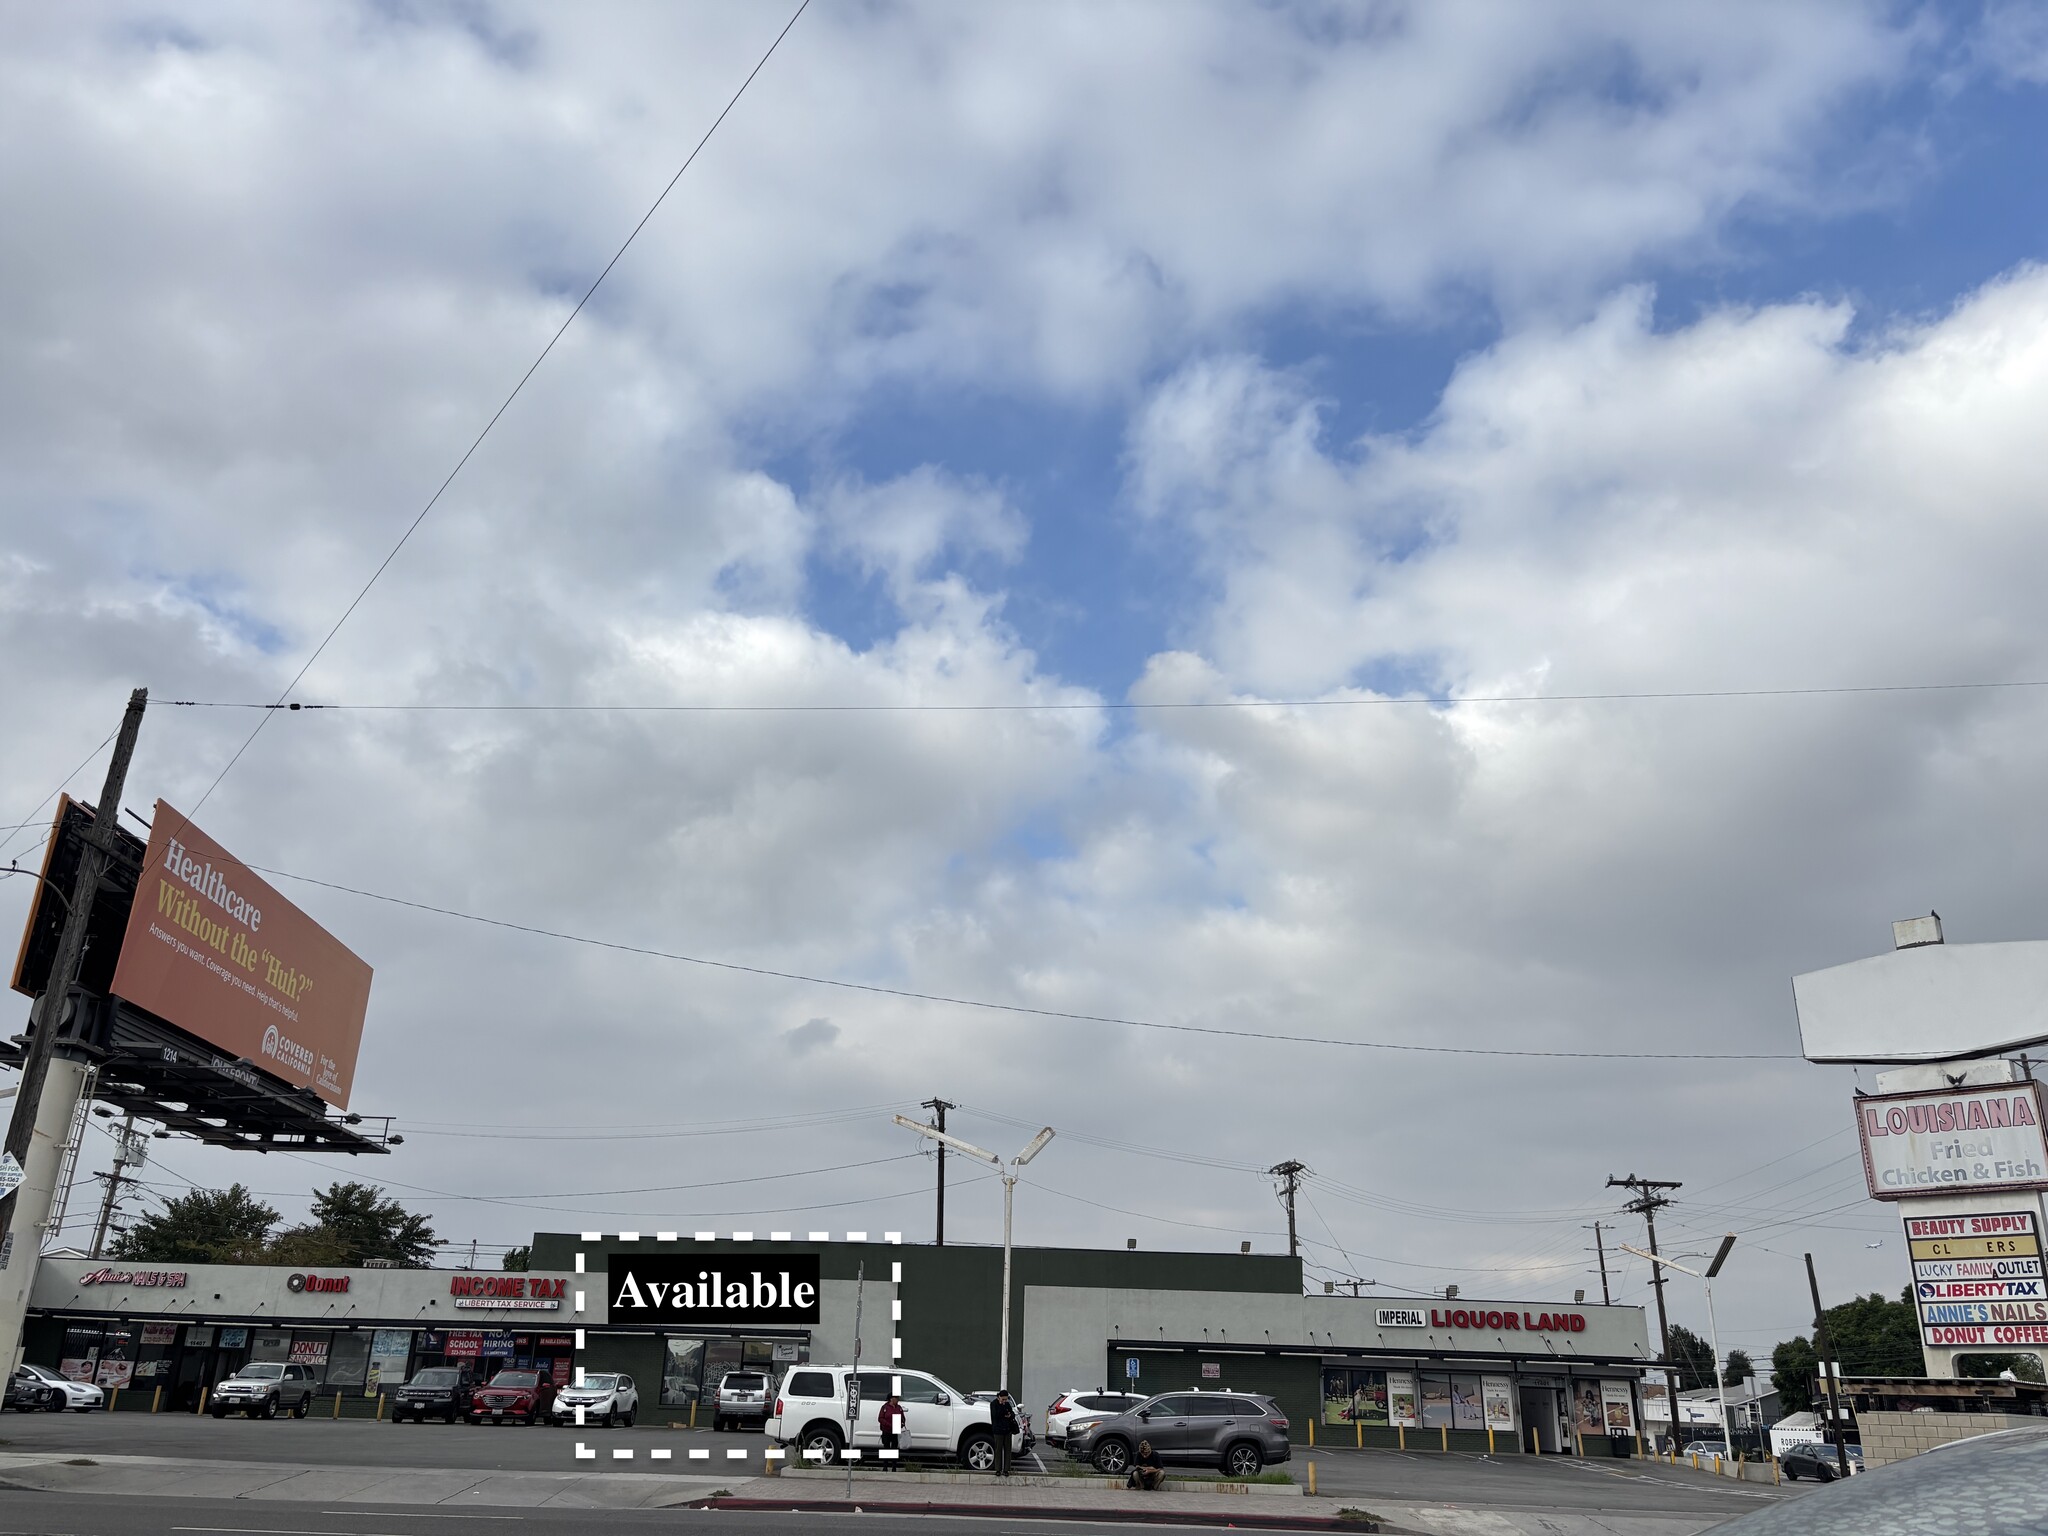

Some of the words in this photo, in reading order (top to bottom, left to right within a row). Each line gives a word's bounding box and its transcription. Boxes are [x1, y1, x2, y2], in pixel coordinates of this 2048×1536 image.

[163, 837, 261, 932] Healthcare
[158, 879, 229, 954] Without
[230, 932, 257, 972] the
[148, 922, 177, 948] Answers
[175, 940, 188, 955] you
[189, 948, 206, 966] want.
[206, 957, 231, 982] Coverage
[231, 973, 242, 987] you
[241, 981, 256, 996] need.
[256, 988, 268, 1005] Help
[163, 1047, 178, 1063] 1214
[279, 1036, 314, 1065] COVERED
[276, 1051, 311, 1077] CALIFORNIA
[320, 1054, 328, 1066] For
[328, 1059, 336, 1071] the
[1866, 1096, 2036, 1137] LOUISIANA
[1930, 1137, 1993, 1161] Fried
[1882, 1166, 1968, 1186] Chicken
[1973, 1162, 1991, 1180] &
[1994, 1158, 2041, 1179] Fish
[1911, 1219, 1965, 1236] BEAUTY
[1971, 1216, 2027, 1233] SUPPLY
[1919, 1264, 1953, 1277] LUCKY
[1956, 1262, 1993, 1276] FAMILY
[1997, 1260, 2039, 1275] OUTLET
[132, 1271, 158, 1286] NAILS
[166, 1272, 187, 1287] SPA
[305, 1274, 350, 1293] Donut
[450, 1276, 525, 1298] INCOME
[528, 1278, 567, 1298] TAX
[464, 1299, 495, 1307] LIBERTY
[513, 1300, 545, 1308] SERVICE
[1927, 1304, 1989, 1322] ANNIE'S
[1990, 1302, 2047, 1321] NAILS
[1379, 1310, 1423, 1325] IMPERIAL
[1431, 1309, 1520, 1330] LIQUOR
[1524, 1312, 1586, 1333] LAND
[449, 1339, 479, 1349] SCHOOL
[483, 1340, 514, 1348] HIRING
[1932, 1327, 1986, 1344] DONUT
[1993, 1325, 2048, 1343] COFFEE
[292, 1342, 327, 1354] DONUT
[289, 1354, 328, 1365] SANDWICH
[1389, 1376, 1414, 1384] Henness
[1482, 1380, 1509, 1389] Hennessy
[1602, 1385, 1628, 1394] Hennessy
